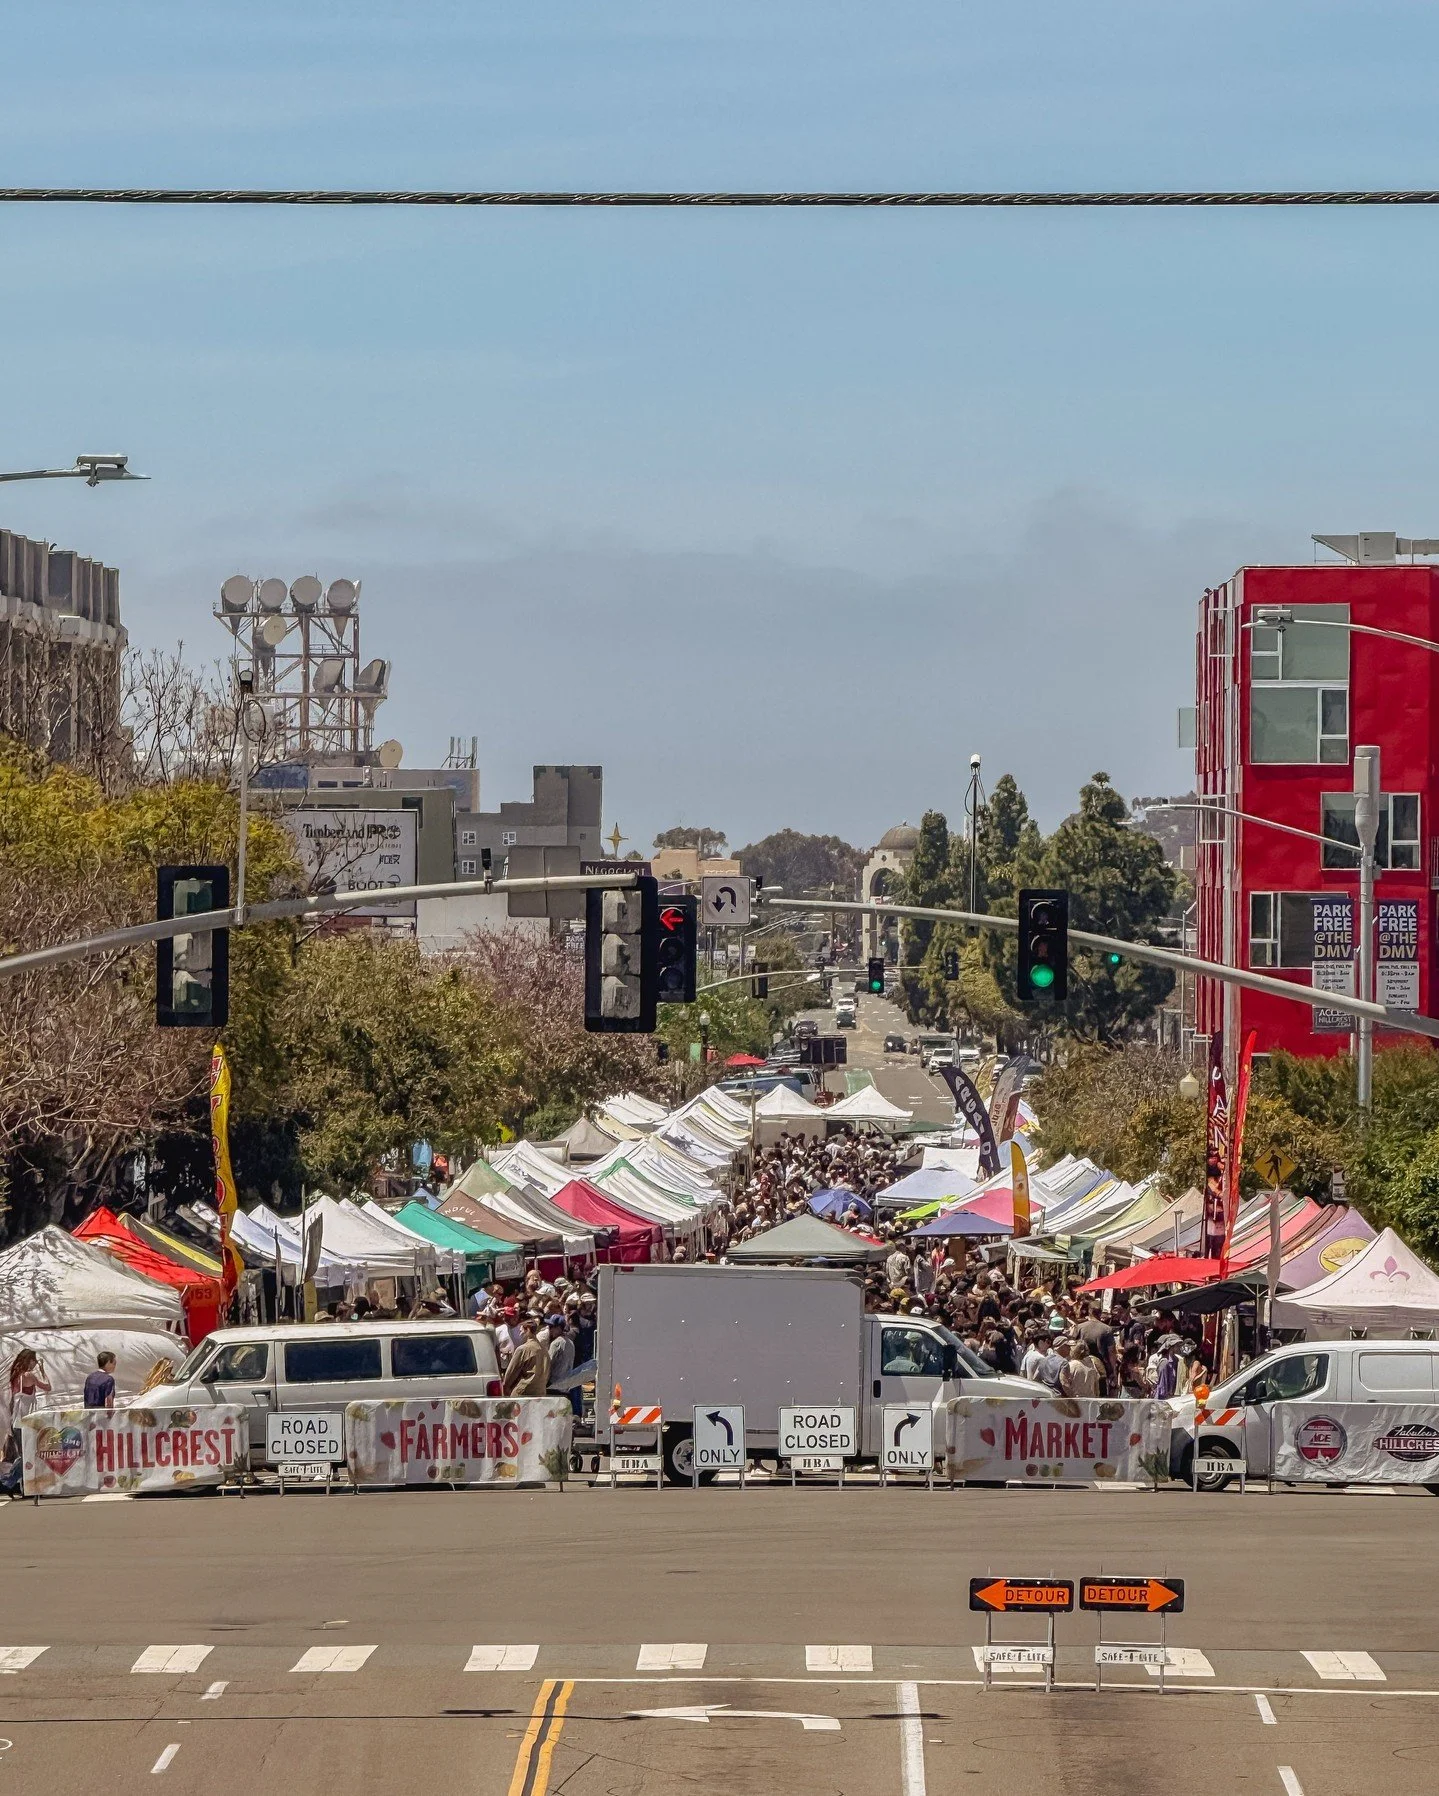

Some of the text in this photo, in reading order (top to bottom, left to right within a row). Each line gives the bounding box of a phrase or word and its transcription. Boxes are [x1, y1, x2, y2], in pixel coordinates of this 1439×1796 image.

[1313, 904, 1352, 917] PARK
[1379, 904, 1417, 917] PARK
[1313, 918, 1352, 931] FREE
[1379, 918, 1418, 931] FREE
[1314, 932, 1352, 943] @THE
[1379, 932, 1418, 943] @THE
[1314, 945, 1352, 958] DMV
[1379, 945, 1416, 958] DMV
[281, 1420, 328, 1434] ROAD
[793, 1415, 841, 1428] ROAD
[1310, 1432, 1331, 1442] ACE
[1393, 1425, 1437, 1437] Fabulous
[400, 1419, 518, 1463] FARMERS
[785, 1434, 850, 1449] CLOSED
[1005, 1417, 1113, 1460] MARKET
[96, 1429, 235, 1472] HILLCREST
[271, 1440, 339, 1455] CLOSED
[700, 1449, 740, 1463] ONLY
[803, 1458, 831, 1467] HBA
[888, 1450, 928, 1464] ONLY
[621, 1459, 649, 1468] HBA
[1206, 1462, 1234, 1471] HBA
[1005, 1589, 1066, 1602] DETOUR
[1087, 1588, 1148, 1601] DETOUR
